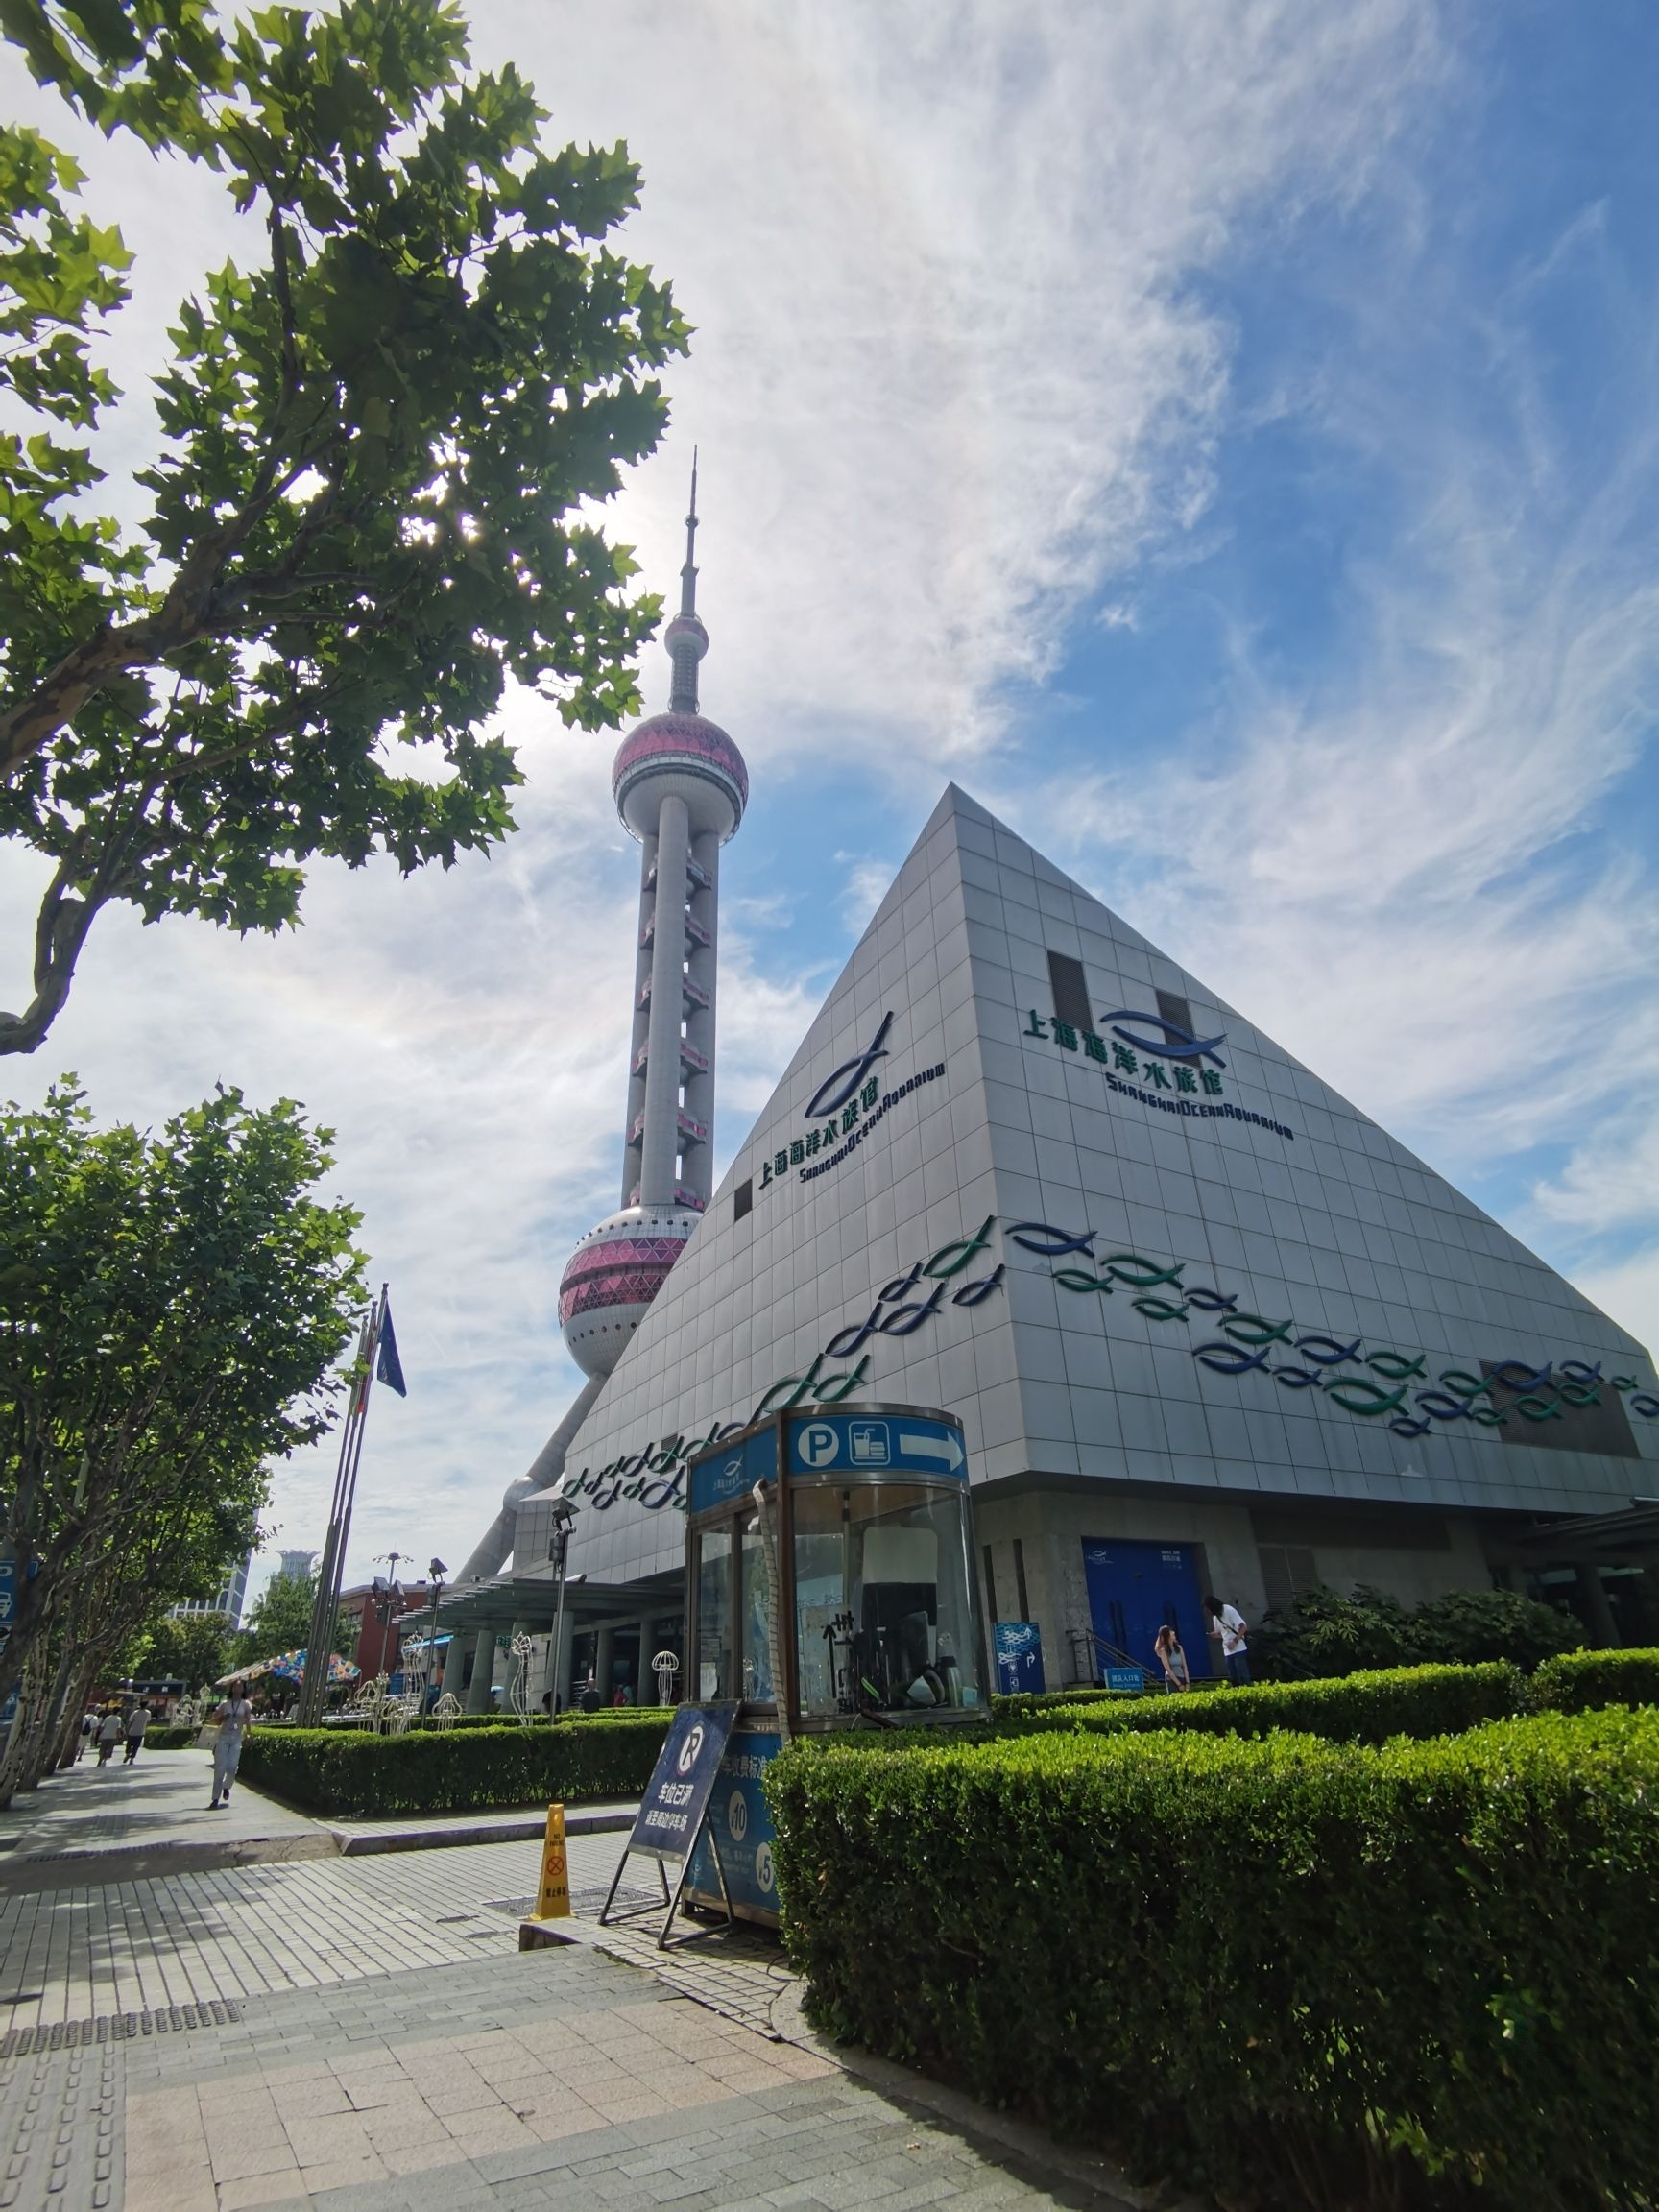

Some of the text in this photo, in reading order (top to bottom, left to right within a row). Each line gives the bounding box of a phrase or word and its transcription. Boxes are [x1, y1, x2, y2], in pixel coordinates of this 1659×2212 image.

[1023, 1009, 1223, 1095] 上海海洋水族馆
[758, 1076, 878, 1190] 上海海洋水族馆
[809, 1430, 833, 1463] P
[658, 1782, 694, 1806] 车位已满
